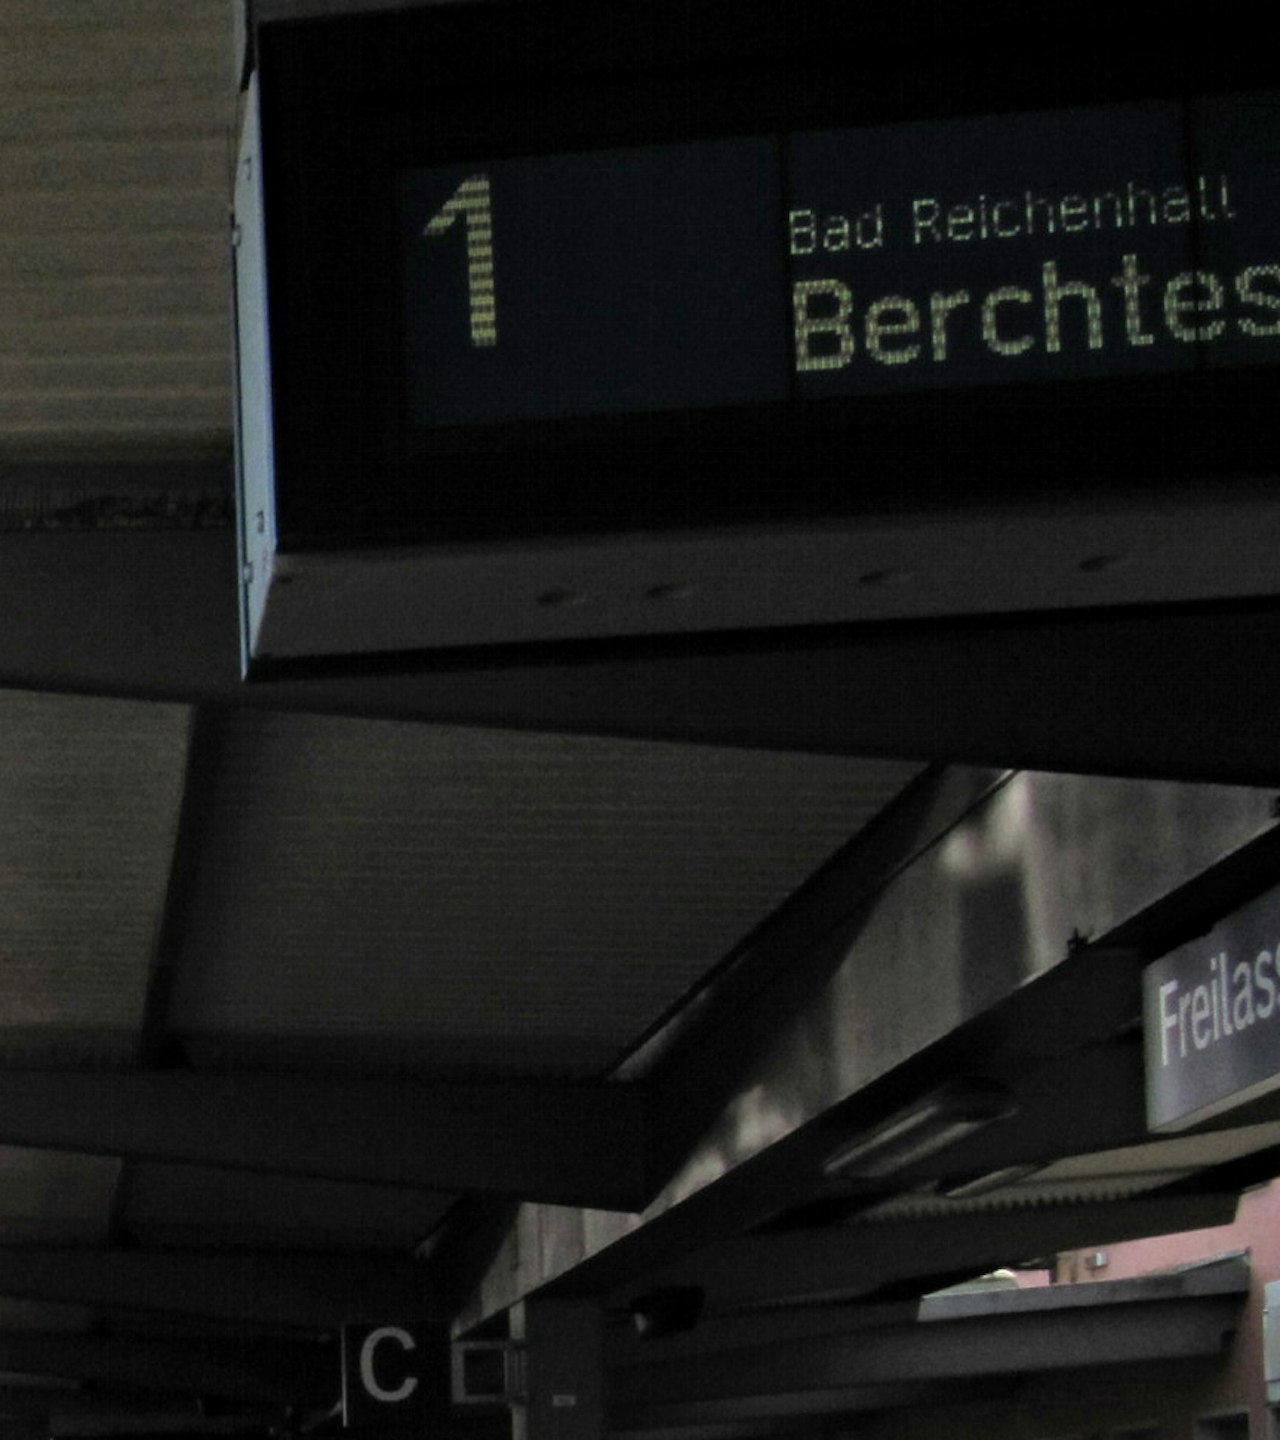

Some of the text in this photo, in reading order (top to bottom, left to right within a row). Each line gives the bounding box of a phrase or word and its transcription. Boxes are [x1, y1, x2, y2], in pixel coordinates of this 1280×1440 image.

[421, 174, 496, 347] 1
[787, 174, 1237, 257] Bad Reichenhall
[791, 252, 1280, 373] Berchtes
[358, 1324, 419, 1402] C
